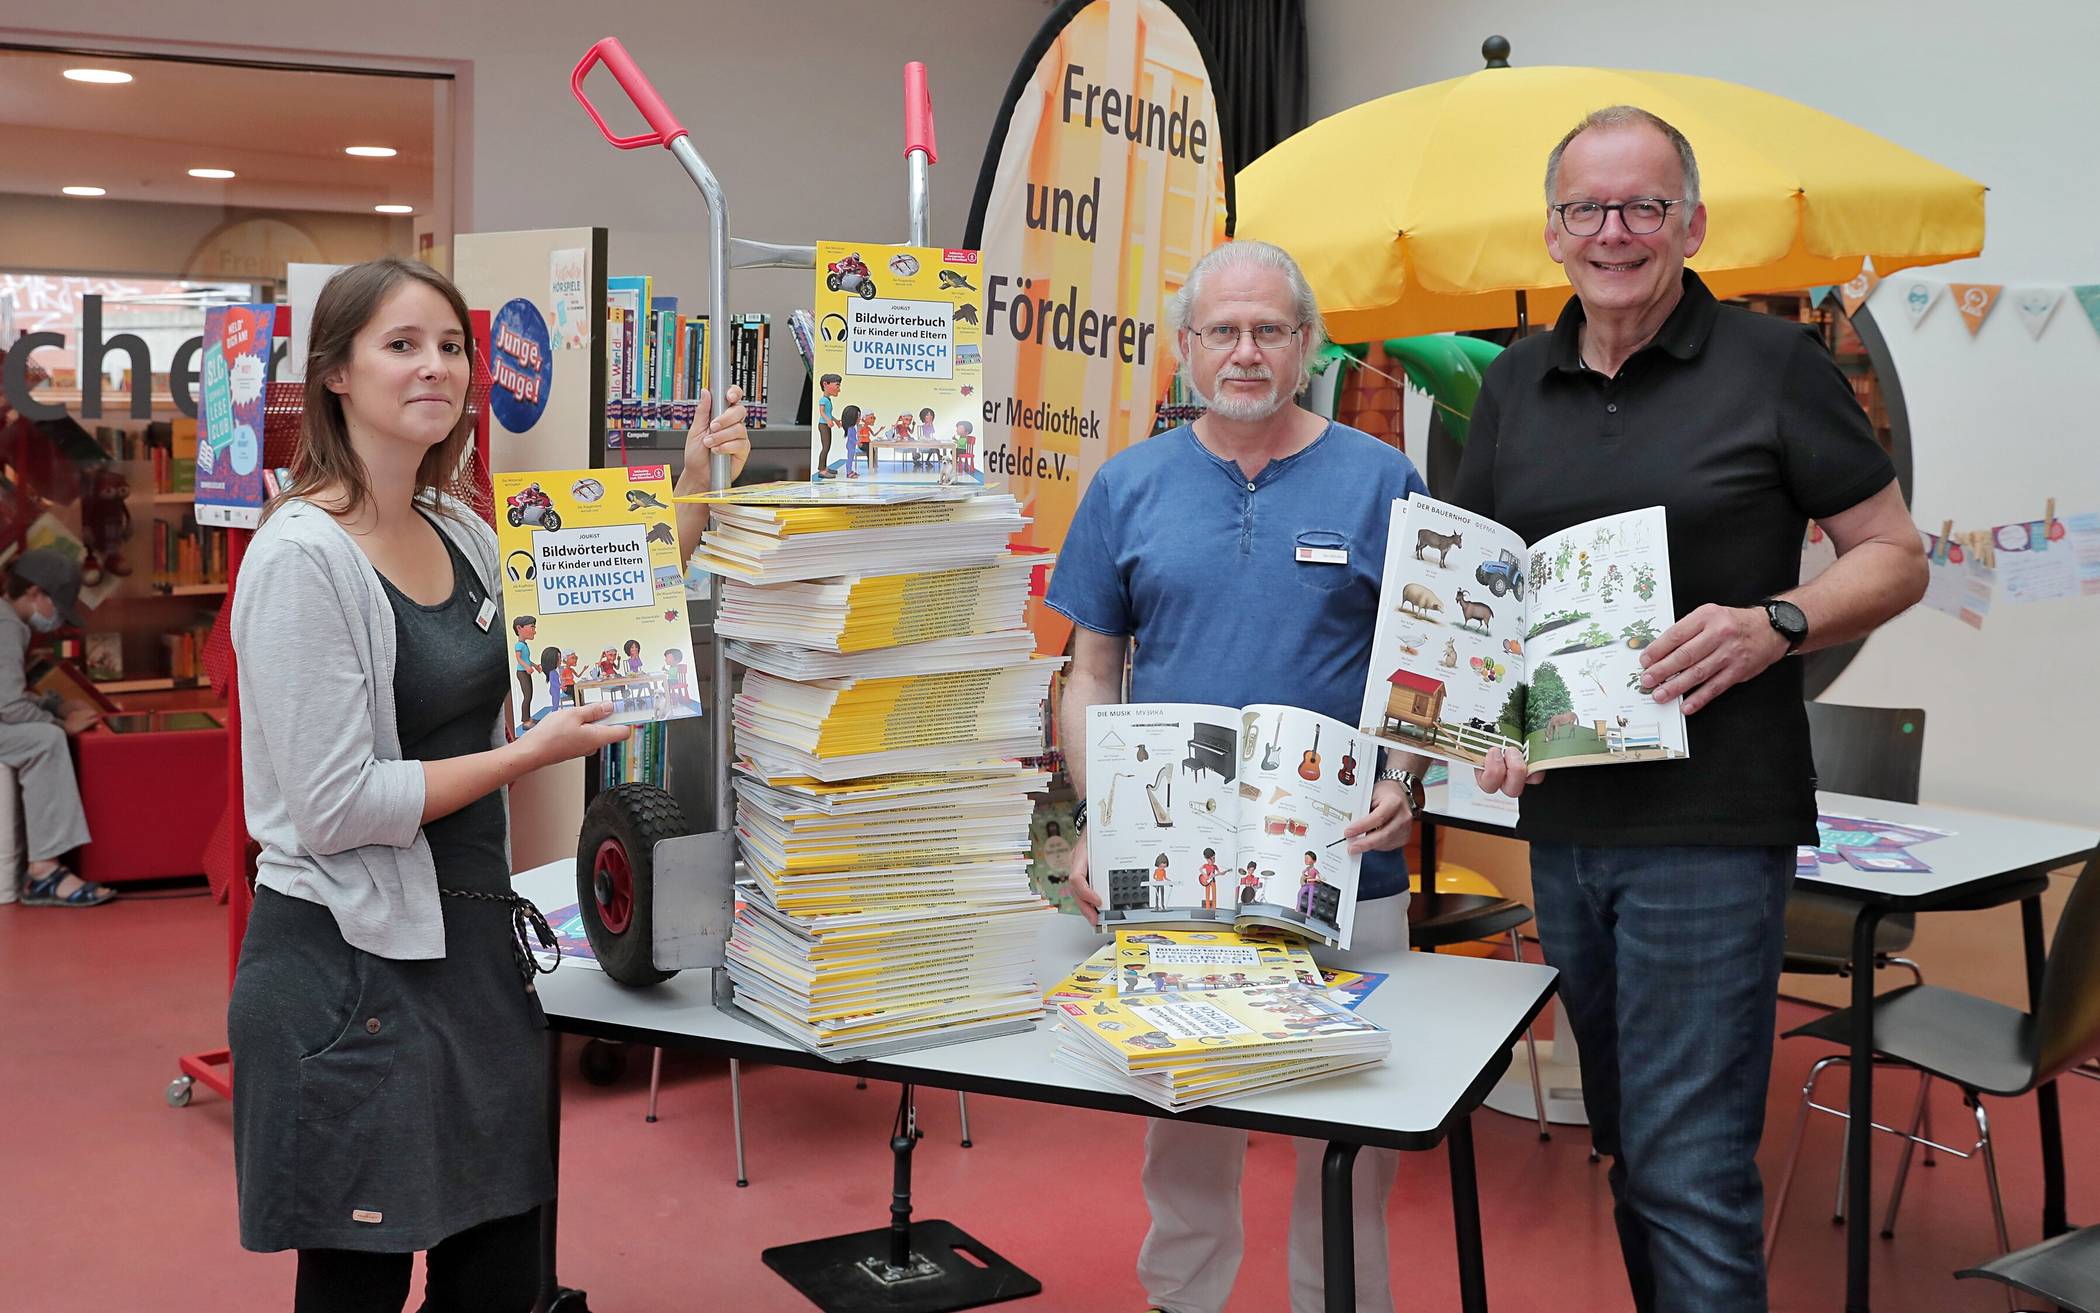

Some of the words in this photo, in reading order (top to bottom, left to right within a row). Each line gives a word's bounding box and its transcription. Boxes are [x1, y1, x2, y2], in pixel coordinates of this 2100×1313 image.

[1063, 63, 1207, 165] Freunde
[1026, 177, 1100, 244] und
[855, 312, 946, 328] Bildwörterbuch
[985, 274, 1155, 366] Förderer
[853, 326, 867, 335] für
[868, 328, 899, 337] Kinder
[900, 330, 918, 338] und
[920, 331, 947, 340] Eltern
[497, 324, 542, 372] Junge,
[853, 340, 947, 358] UKRAINISCH
[863, 356, 935, 372] DEUTSCH
[493, 358, 541, 404] Junge!
[983, 400, 1001, 423] er
[1006, 397, 1100, 440] Mediothek
[1416, 501, 1430, 512] DER
[1431, 505, 1472, 524] BAUERNHOF
[542, 540, 640, 558] Bildwörterbuch
[541, 561, 556, 571] für
[558, 559, 591, 570] Kinder
[592, 557, 612, 568] und
[614, 556, 643, 567] Eltern
[543, 569, 645, 590] UKRAINISCH
[557, 587, 635, 606] DEUTSCH
